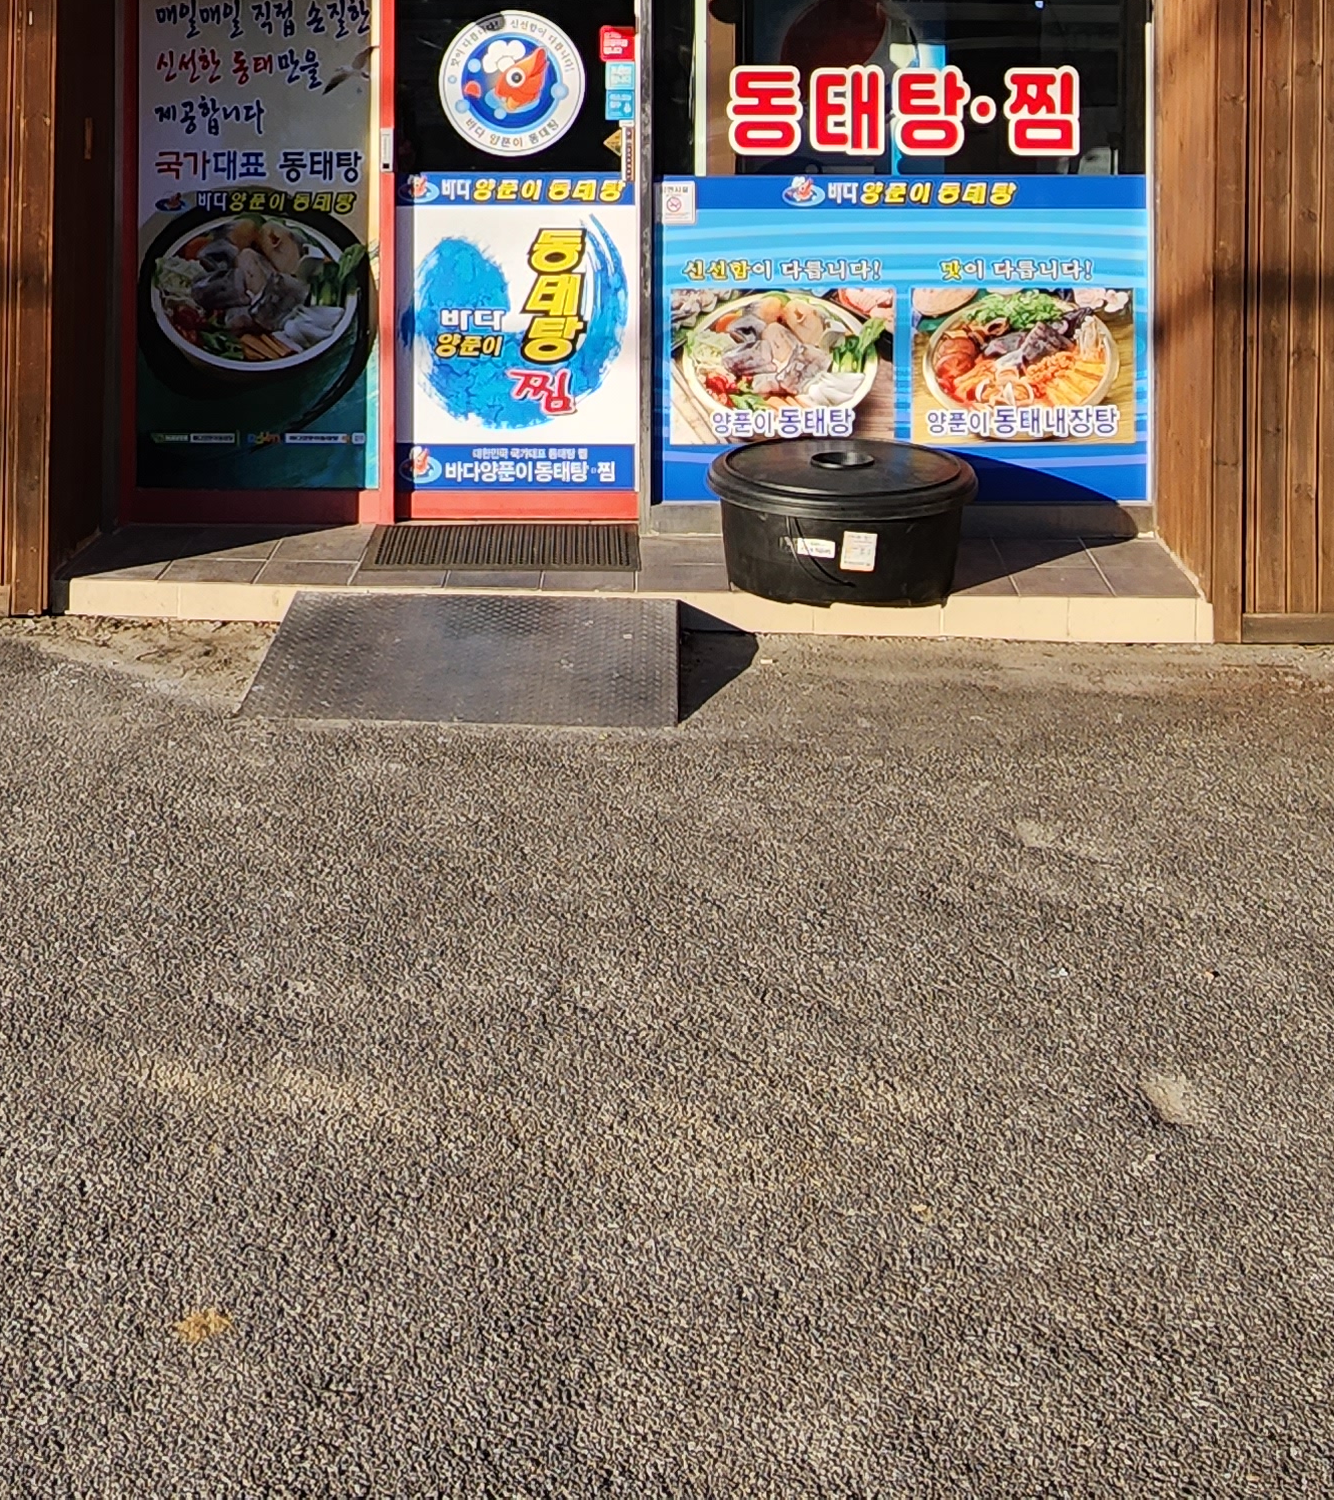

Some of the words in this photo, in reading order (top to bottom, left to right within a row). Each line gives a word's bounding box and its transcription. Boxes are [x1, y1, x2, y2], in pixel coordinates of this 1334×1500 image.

[252, 0, 295, 39] 직접
[156, 48, 222, 83] 신선한
[231, 48, 322, 89] 동태만을
[154, 96, 265, 136] 제공합니다
[154, 150, 266, 181] 국가대표
[278, 150, 362, 183] 동태탕
[292, 191, 357, 213] 동태탕
[547, 178, 626, 203] 동태탕
[936, 183, 1018, 206] 동태탕
[682, 259, 773, 280] 신선함이
[780, 259, 882, 282] 다릅니다!
[940, 259, 985, 281] 맛이
[992, 259, 1094, 283] 다릅니다!
[519, 227, 587, 365] 동태탕
[439, 308, 507, 332] 바다
[434, 332, 504, 359] 양푼이
[505, 368, 578, 416] 찜
